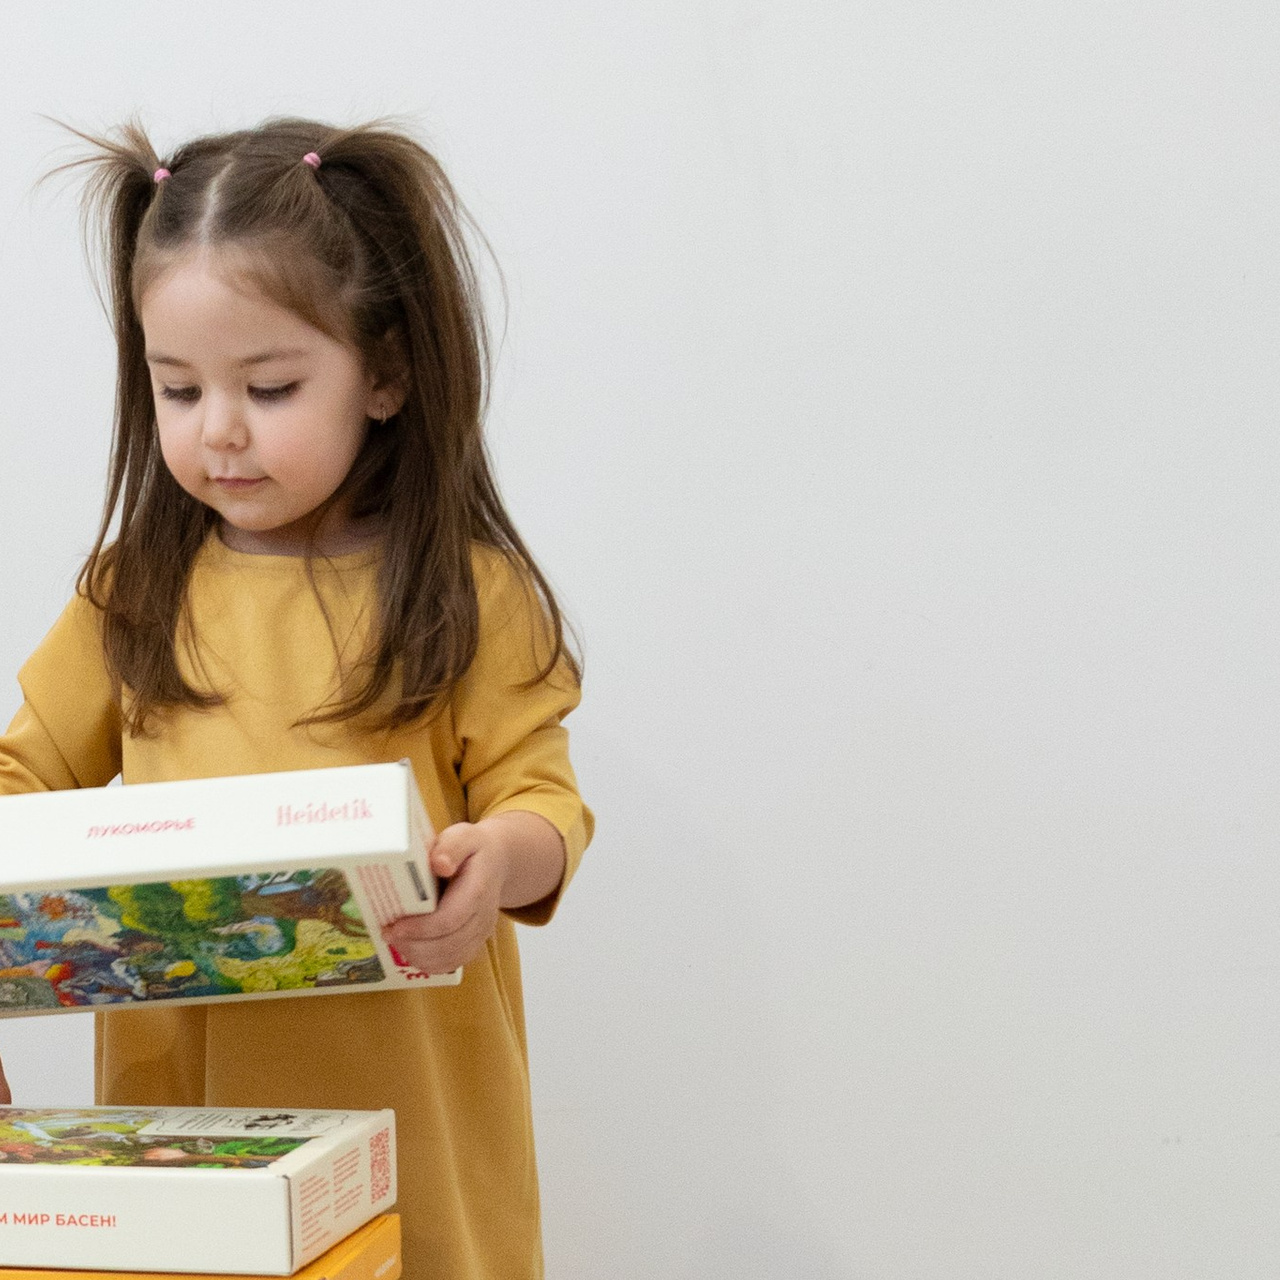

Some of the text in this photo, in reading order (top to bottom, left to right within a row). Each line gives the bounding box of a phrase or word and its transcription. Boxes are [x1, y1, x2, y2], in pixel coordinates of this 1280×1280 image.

[277, 798, 373, 827] Heidetik
[87, 817, 195, 838] ЛУКОМОРЬЕ
[13, 1212, 51, 1227] МИР
[55, 1213, 117, 1228] БАСЕН!
